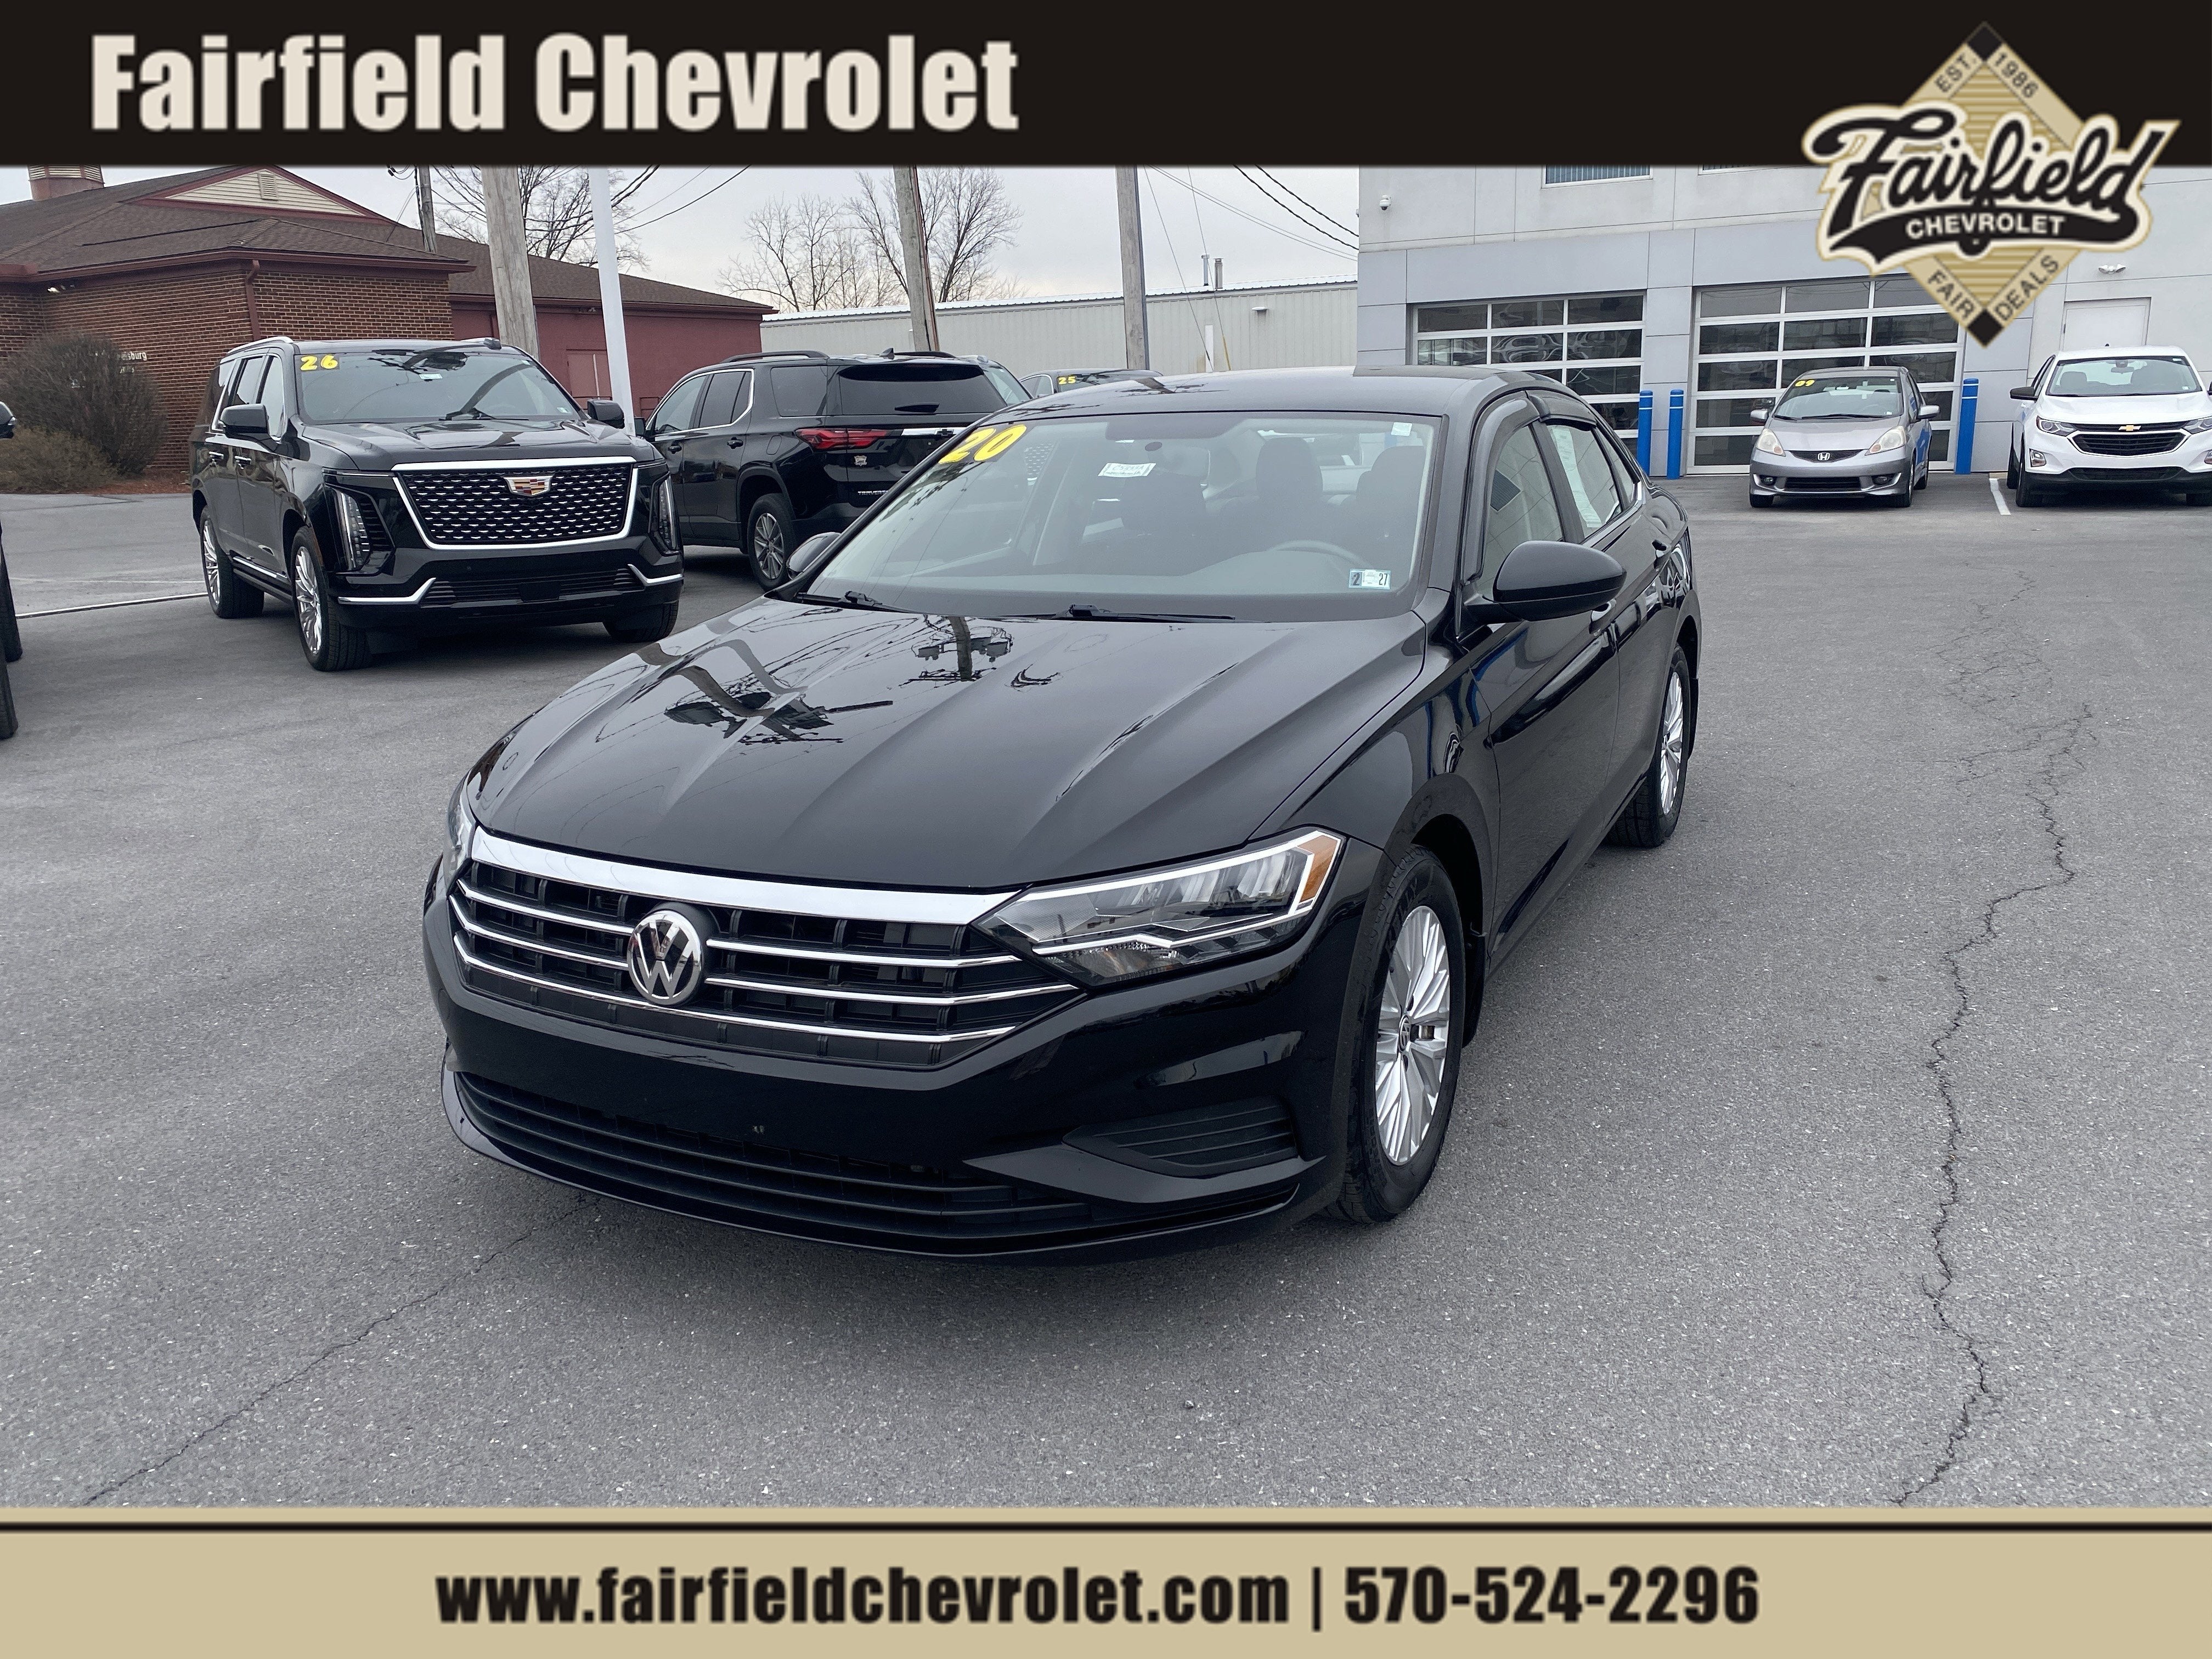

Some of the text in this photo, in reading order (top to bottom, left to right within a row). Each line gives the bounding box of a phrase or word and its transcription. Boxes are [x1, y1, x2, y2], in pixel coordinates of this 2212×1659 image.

[300, 355, 338, 371] 26
[1058, 376, 1076, 385] 25
[938, 425, 1027, 464] 20
[1352, 572, 1388, 586] 2 27
